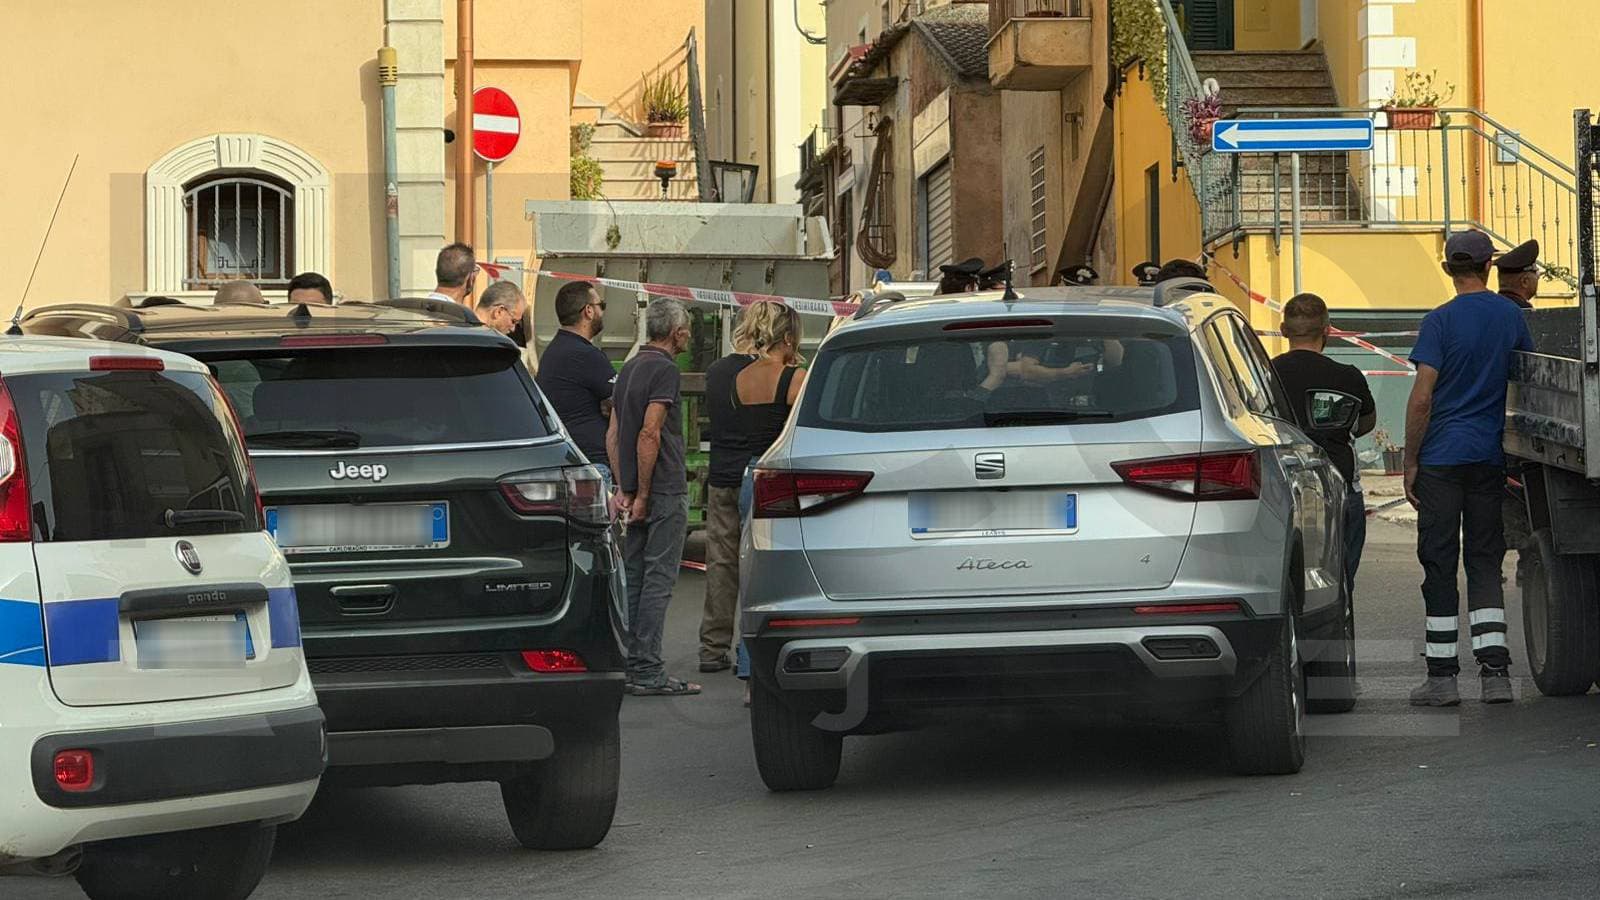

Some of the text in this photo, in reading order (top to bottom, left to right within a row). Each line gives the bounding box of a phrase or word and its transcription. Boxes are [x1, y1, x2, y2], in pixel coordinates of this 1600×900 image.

[329, 461, 388, 481] Jeep
[956, 557, 1032, 571] Ateca
[1140, 553, 1152, 565] 4
[485, 582, 553, 592] LIMITED
[187, 590, 227, 604] panda
